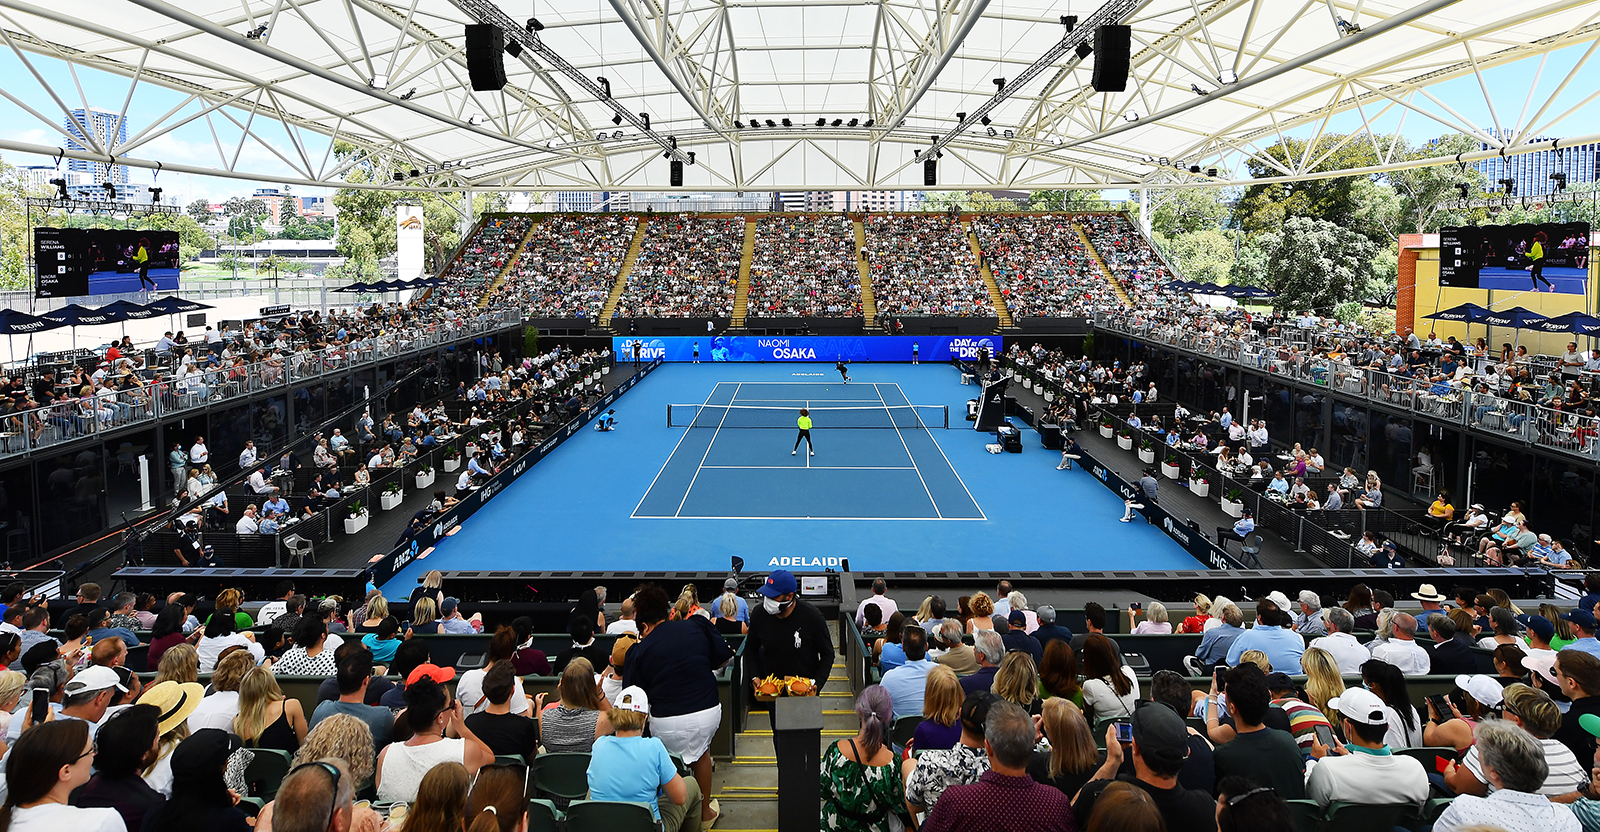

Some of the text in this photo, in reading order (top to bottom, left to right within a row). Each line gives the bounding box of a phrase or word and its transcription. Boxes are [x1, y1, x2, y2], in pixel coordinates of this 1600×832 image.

[78, 315, 106, 323] PERONI
[1485, 316, 1511, 324] PERONI
[10, 321, 45, 331] PERONI
[1541, 322, 1570, 330] PERONI
[626, 339, 643, 347] DY
[758, 339, 789, 347] NAOMI
[954, 338, 972, 347] DAY
[773, 348, 816, 359] OSAKA
[480, 486, 492, 502] IHG
[392, 548, 411, 572] ANZ
[1210, 550, 1227, 570] IHG
